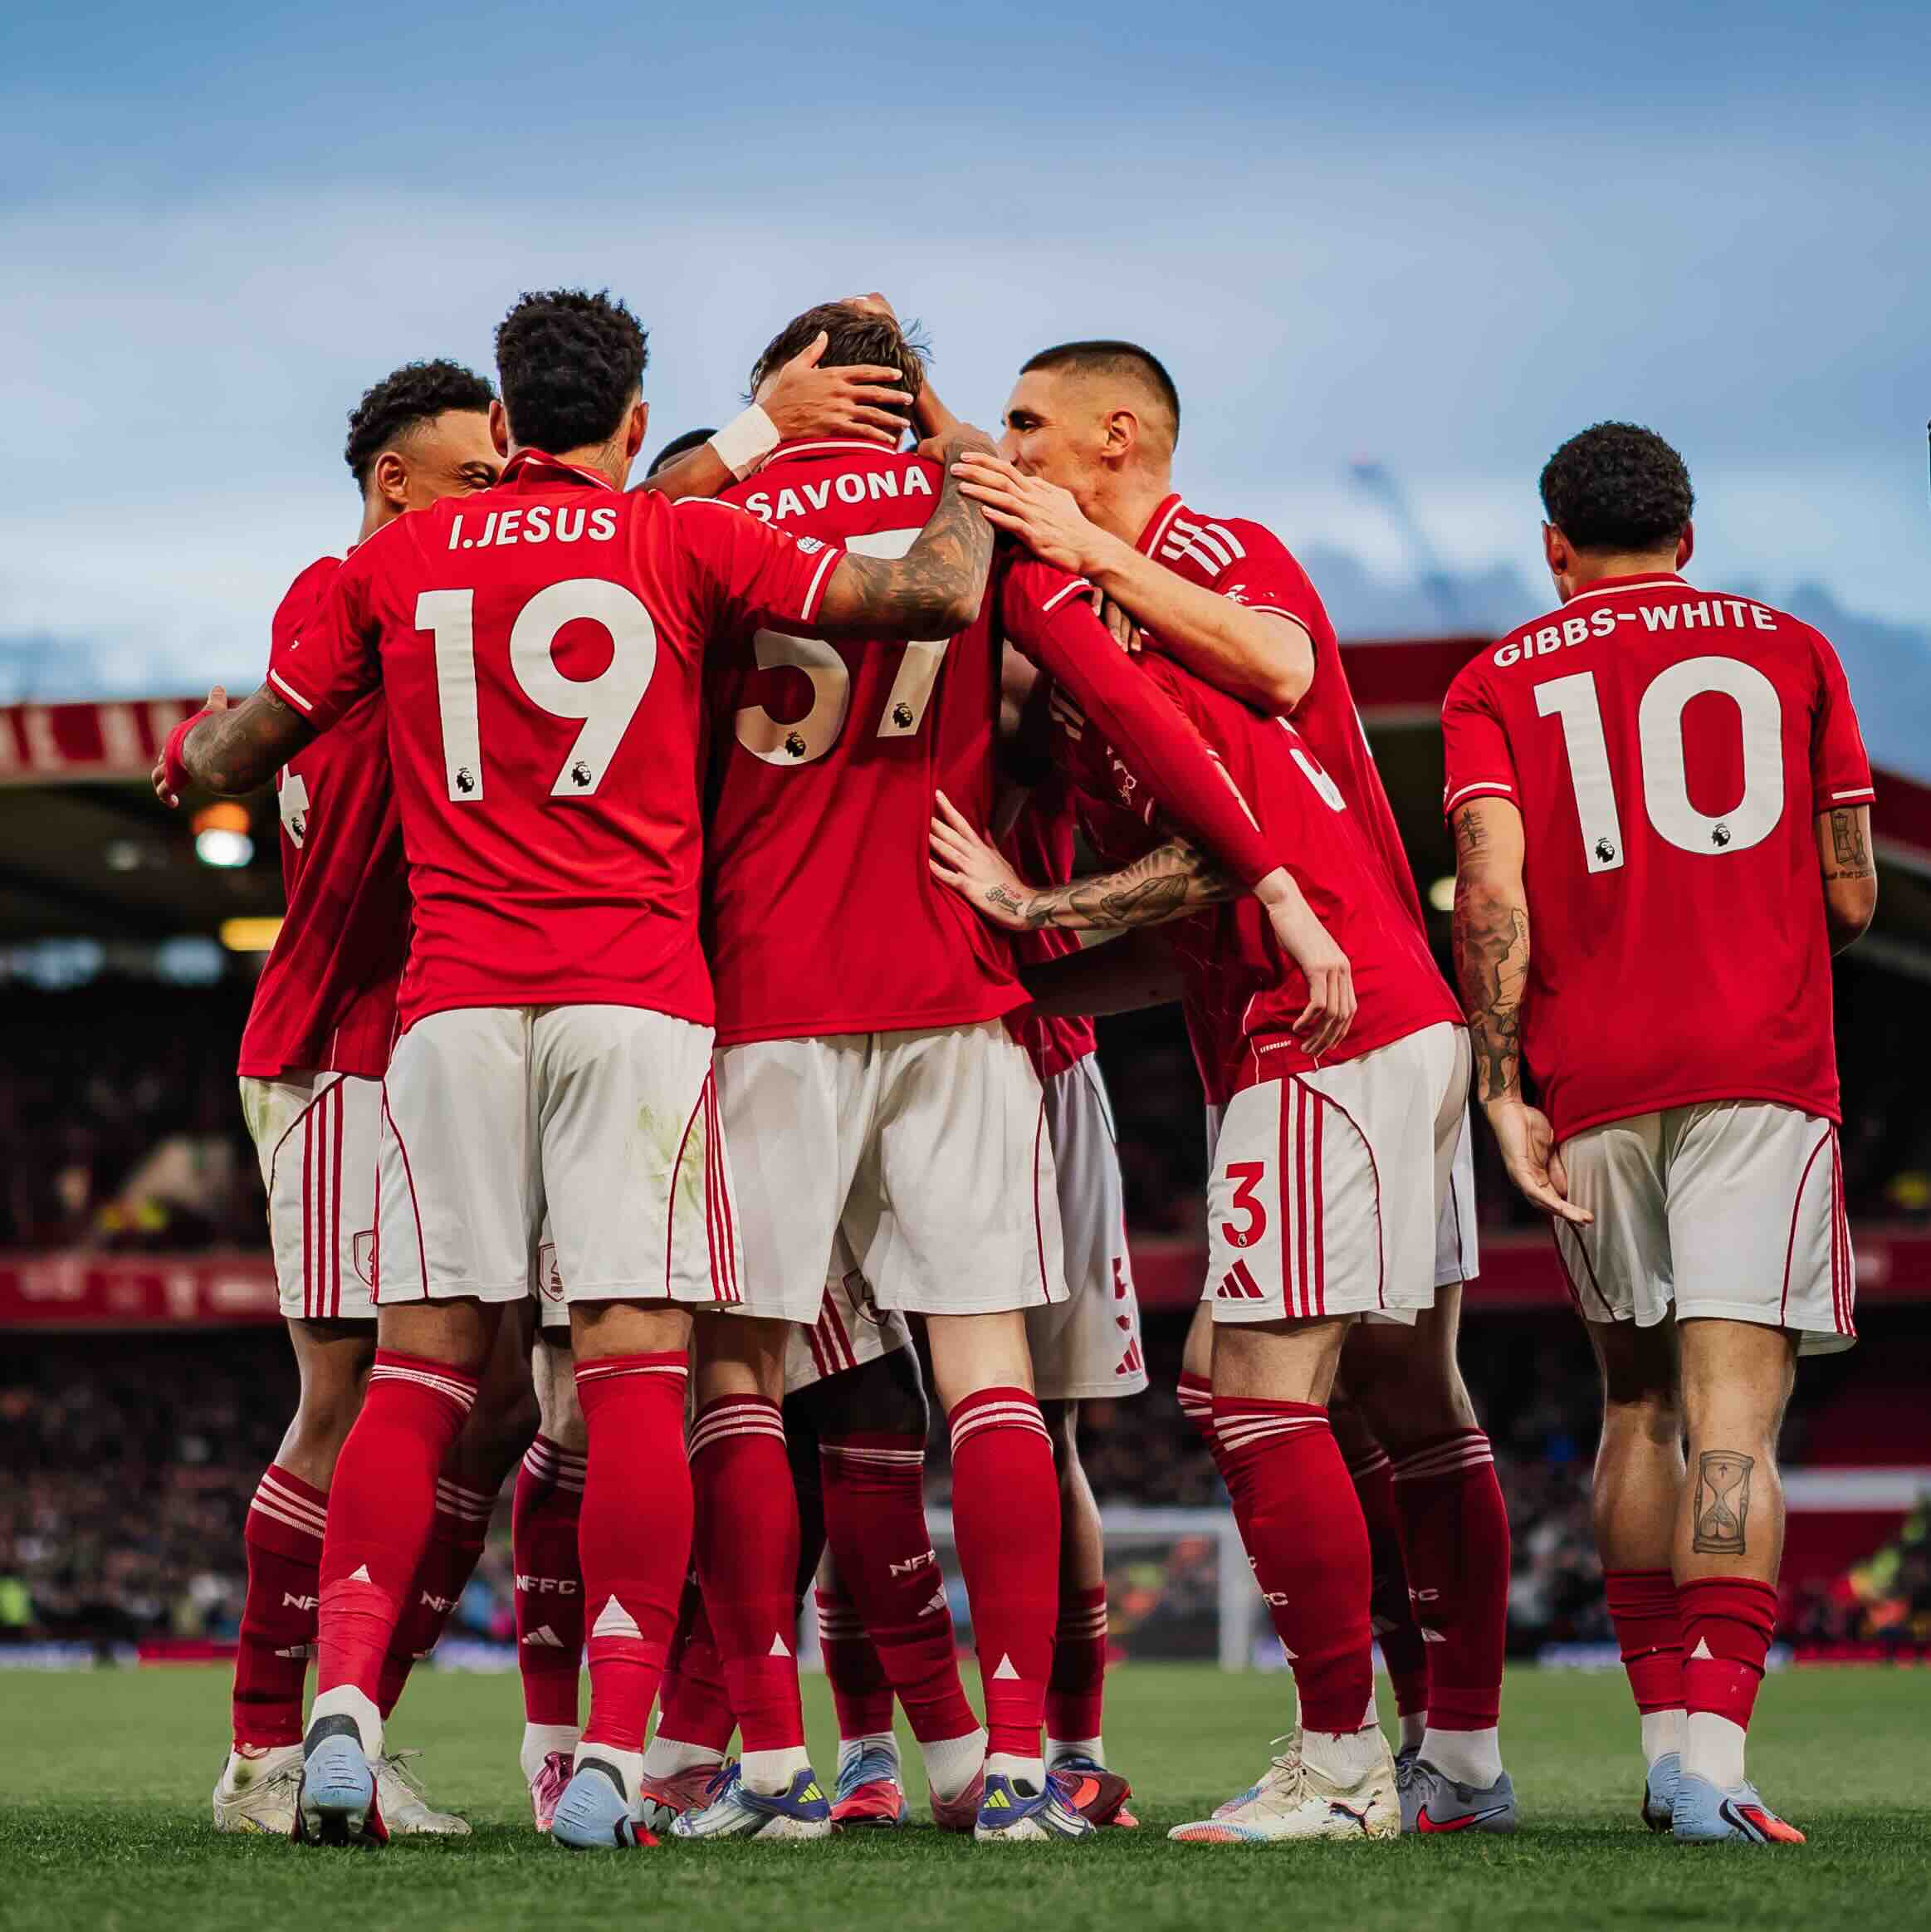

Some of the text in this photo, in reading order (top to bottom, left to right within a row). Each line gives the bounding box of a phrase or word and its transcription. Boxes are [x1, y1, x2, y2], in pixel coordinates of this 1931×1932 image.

[448, 506, 617, 550] I.JESUS
[745, 466, 932, 523] SAVONA
[1493, 599, 1777, 667] GIBBS-WHITE
[415, 578, 658, 802] 19
[1533, 656, 1785, 874] 10
[1221, 1160, 1267, 1249] 3
[516, 1574, 577, 1594] NFFC
